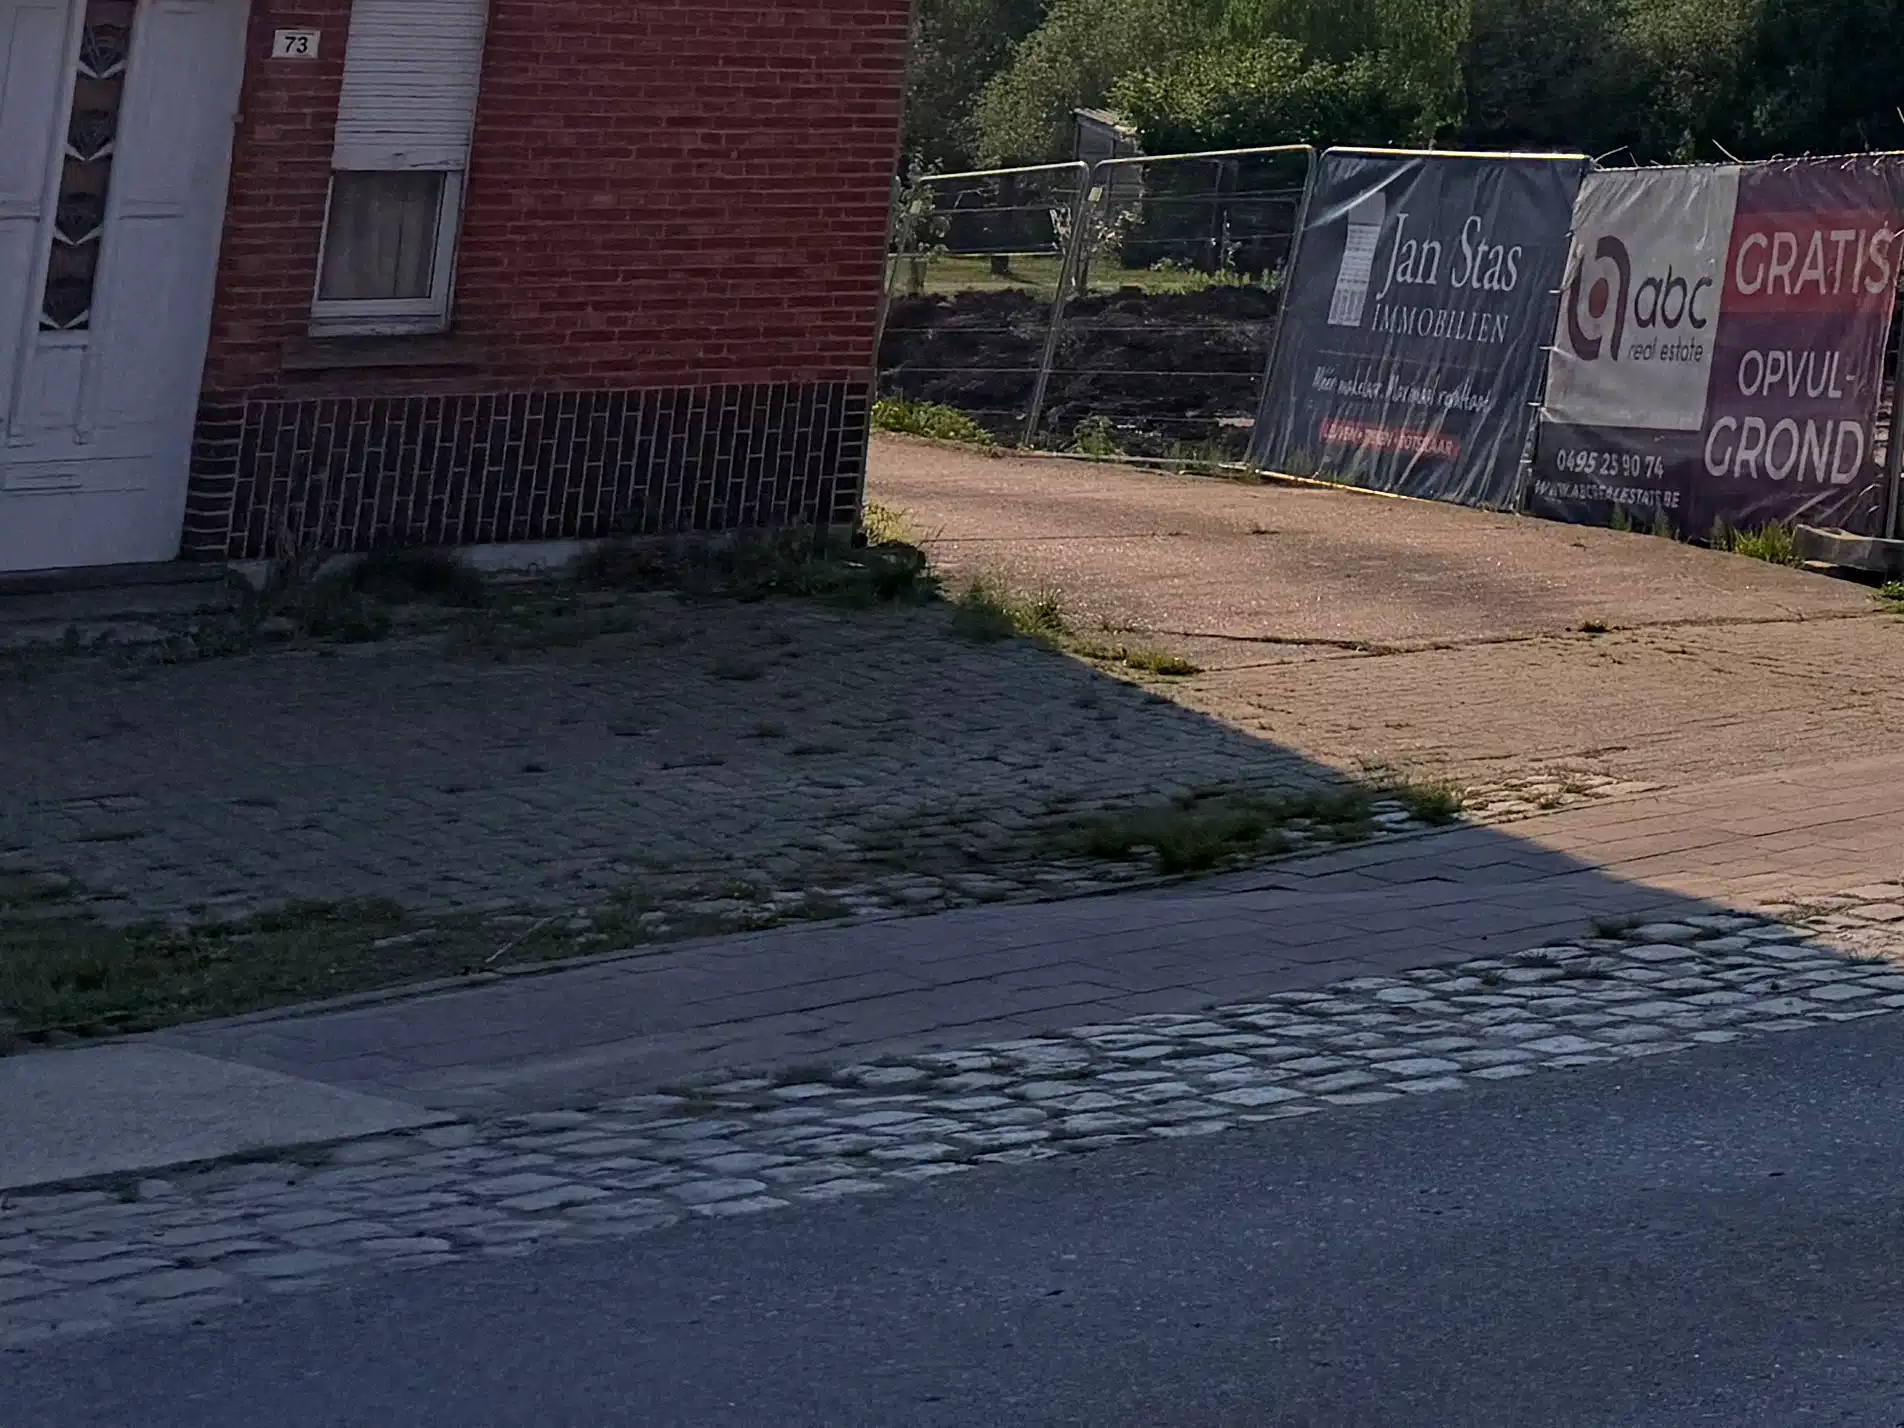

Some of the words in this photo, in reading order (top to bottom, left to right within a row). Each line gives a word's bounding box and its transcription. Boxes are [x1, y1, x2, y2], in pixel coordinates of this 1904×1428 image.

[285, 36, 308, 53] 73
[1375, 213, 1442, 300] Jan
[1451, 215, 1522, 292] Stas
[1735, 227, 1892, 295] GRATIS
[1634, 264, 1713, 329] abc
[1371, 303, 1508, 344] IMMOBILIEN
[1628, 336, 1657, 361] real
[1660, 336, 1704, 362] estate
[1738, 349, 1858, 399] OPVUL-
[1556, 448, 1598, 473] 0495
[1600, 452, 1619, 476] 25
[1622, 454, 1641, 477] 90
[1644, 456, 1664, 479] 74
[1704, 416, 1864, 484] GROND
